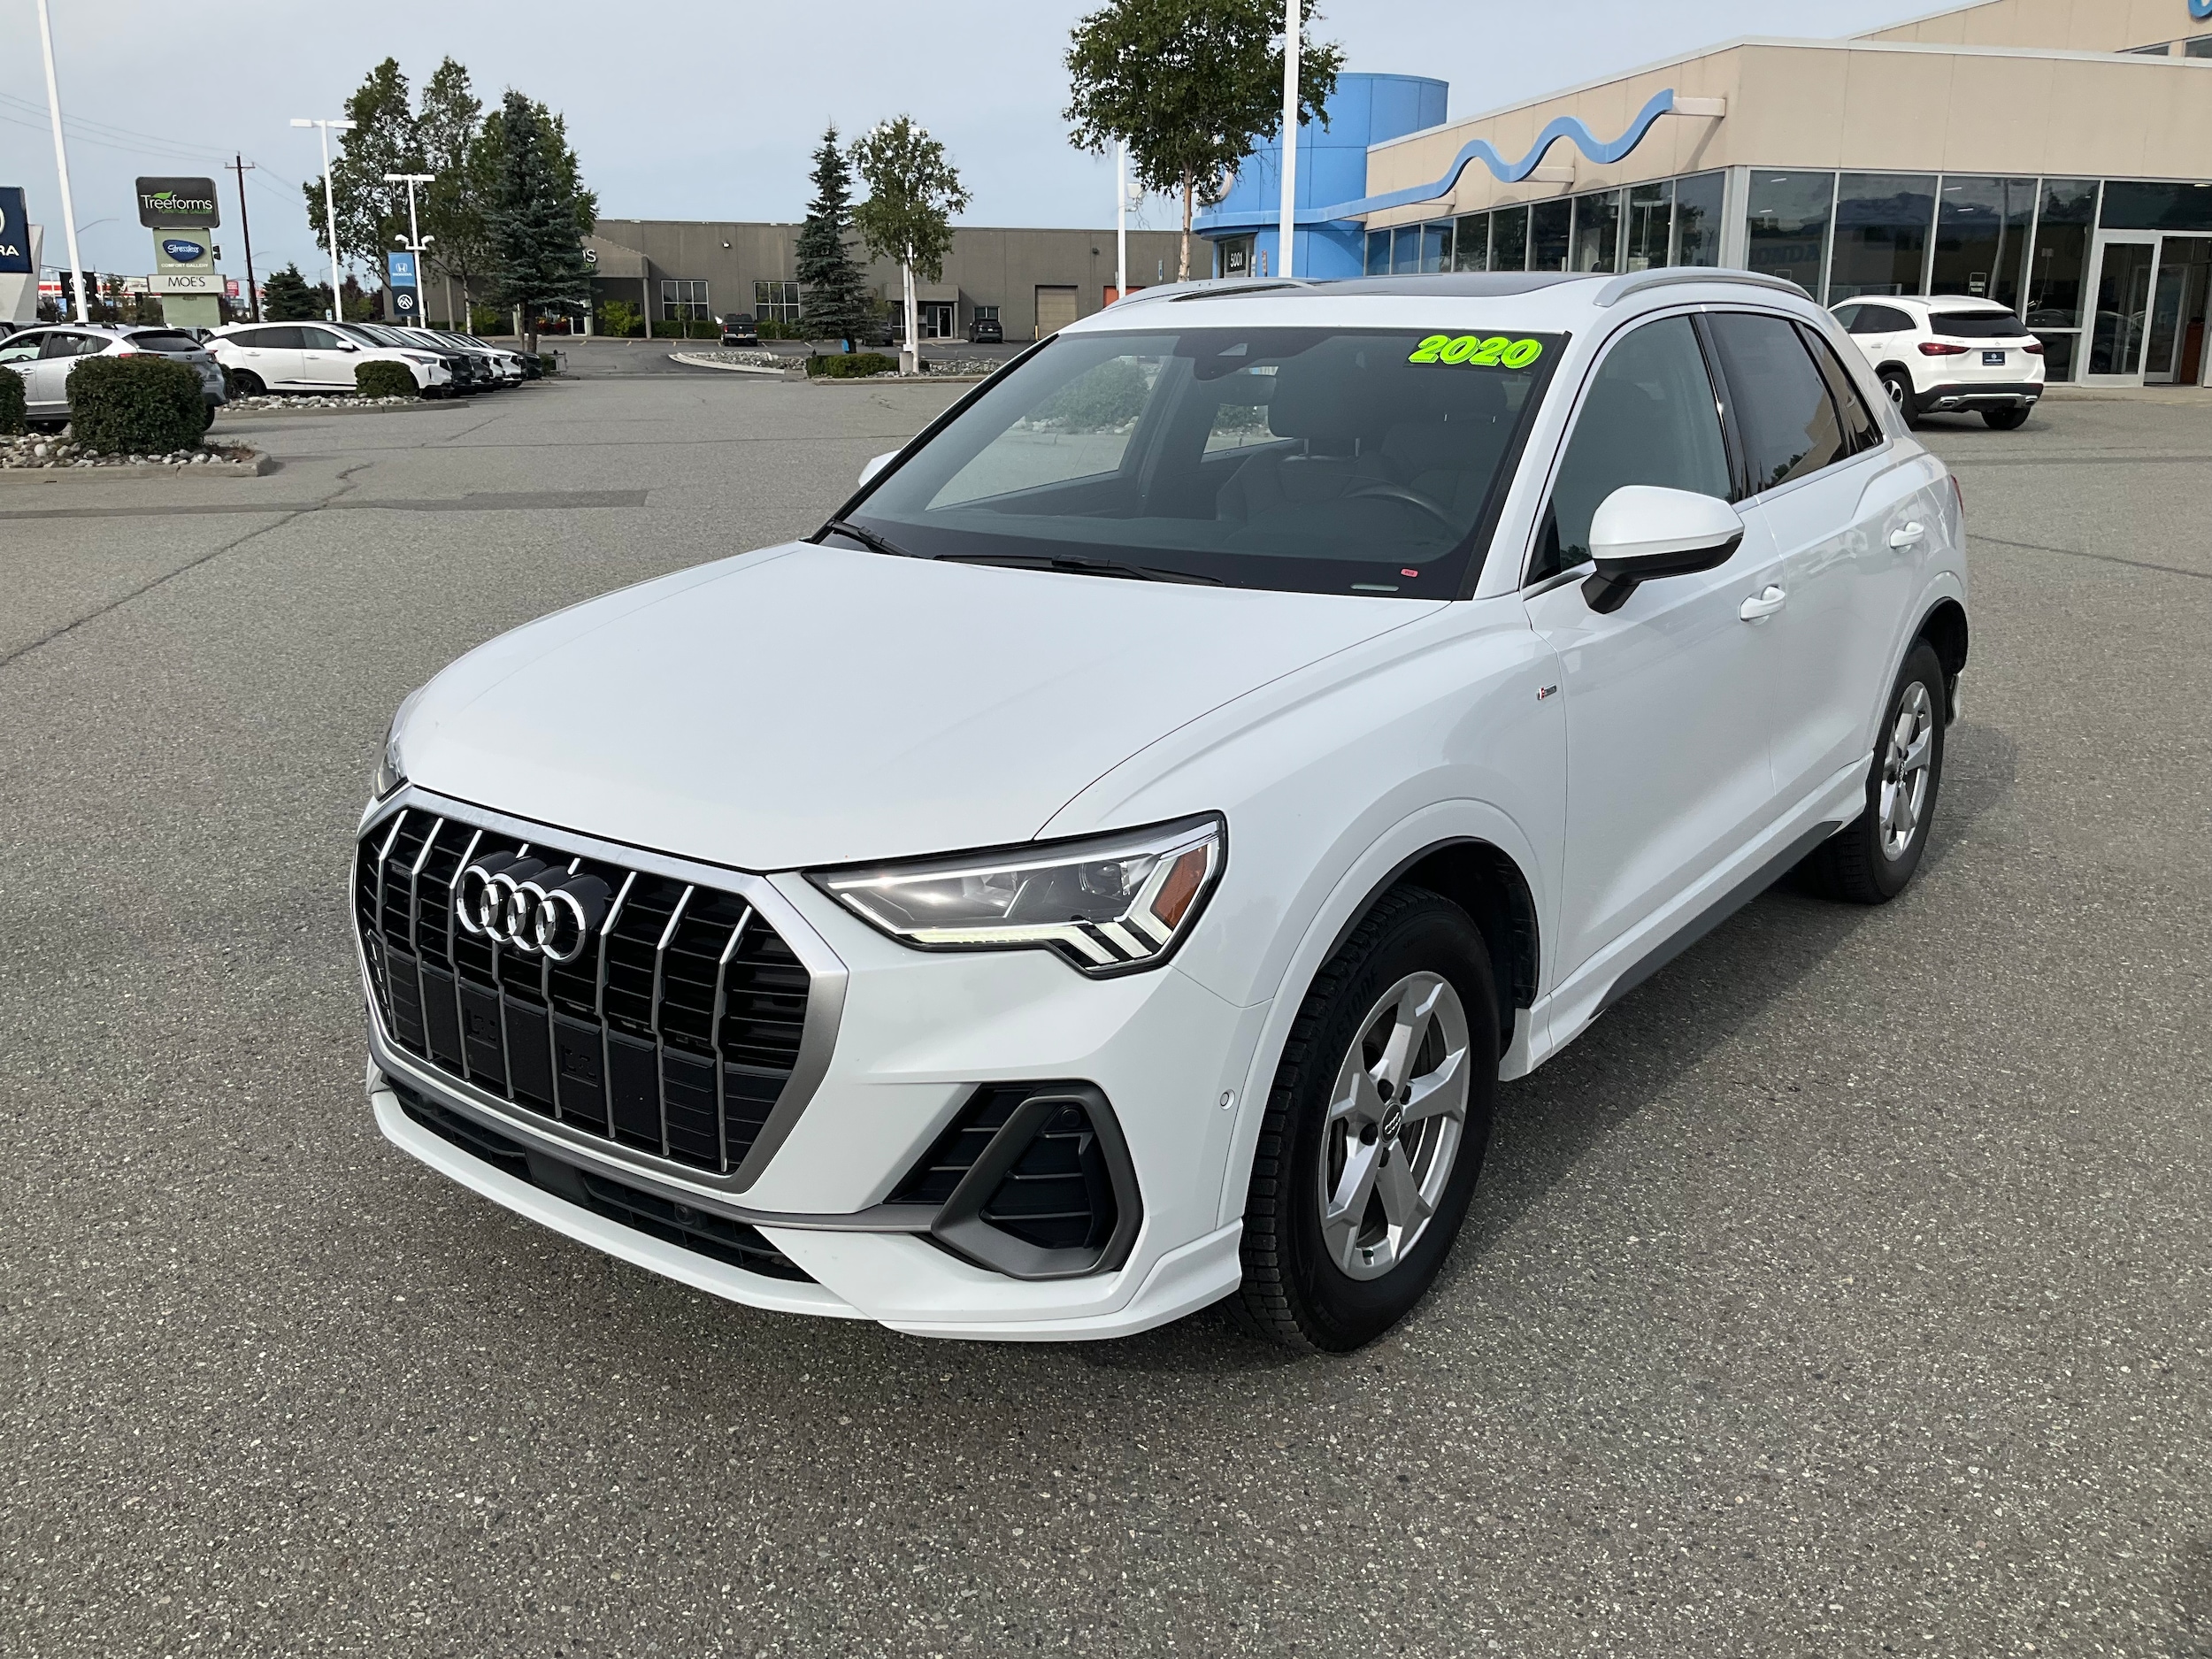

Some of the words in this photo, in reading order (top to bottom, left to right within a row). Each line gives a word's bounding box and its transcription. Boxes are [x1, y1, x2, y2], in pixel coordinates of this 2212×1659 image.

[141, 195, 212, 210] Treeforms
[167, 244, 199, 254] Stressless
[1231, 252, 1242, 267] 5001
[168, 276, 205, 287] MOE'S
[1408, 334, 1543, 369] 2020
